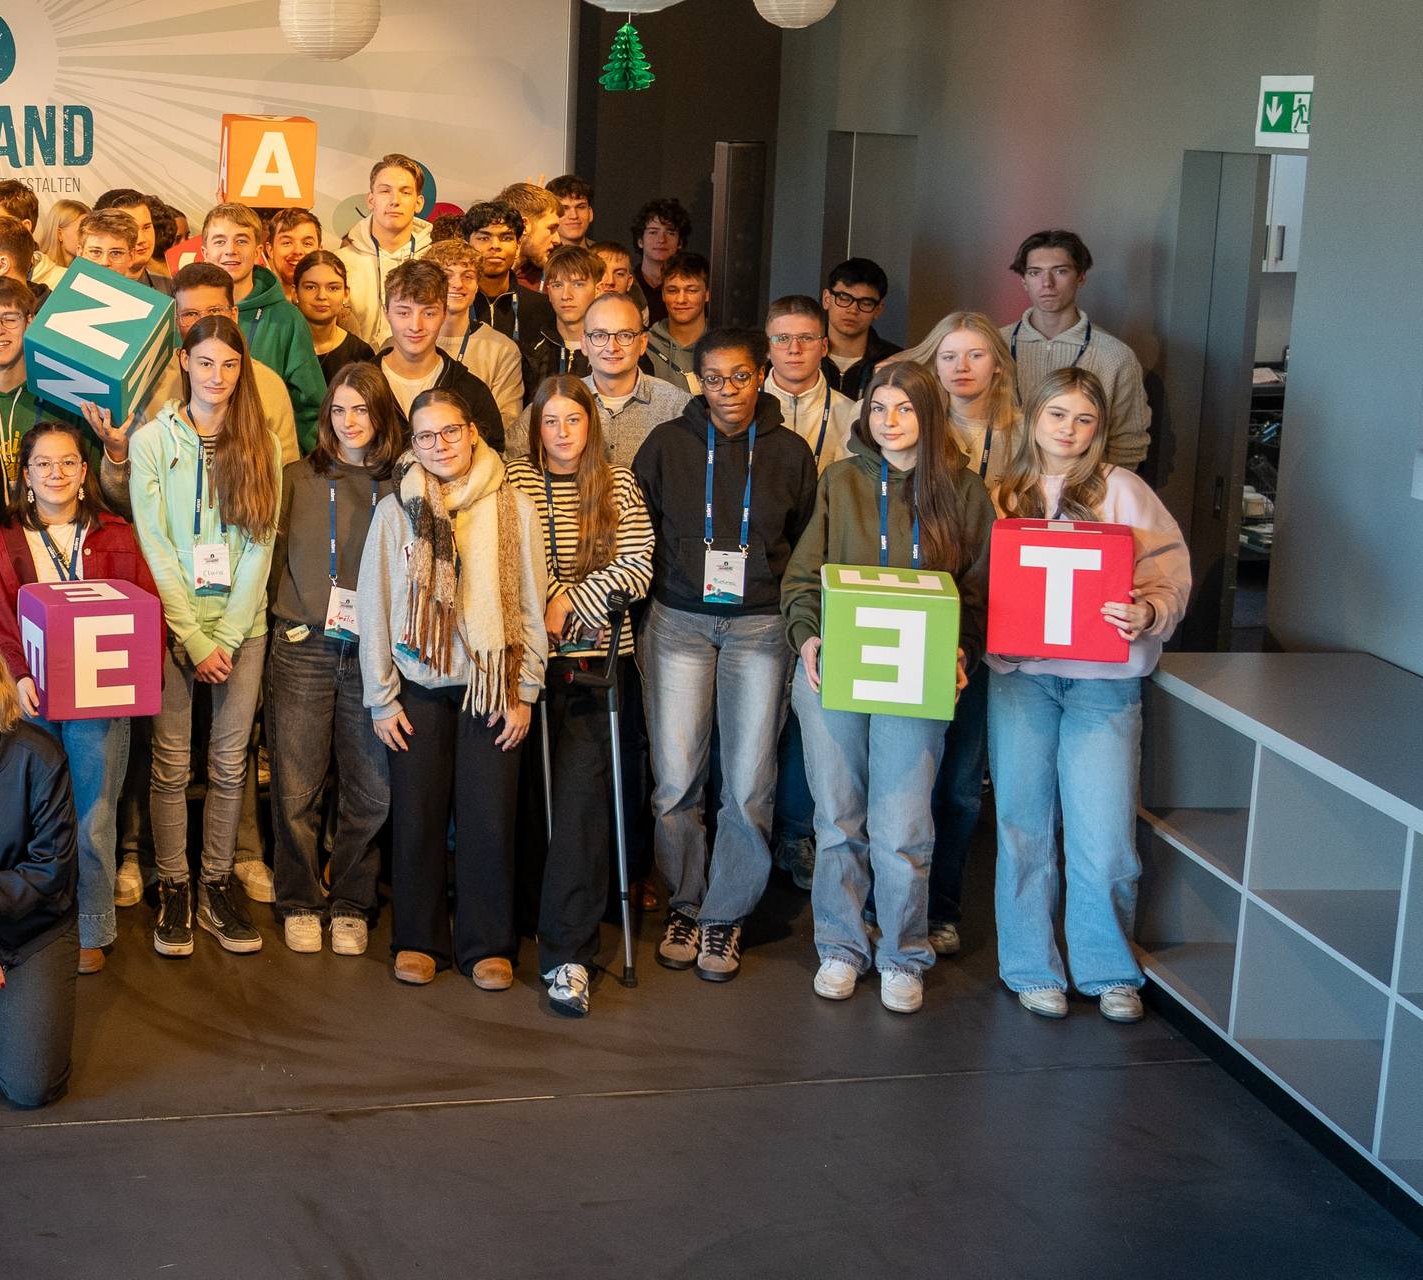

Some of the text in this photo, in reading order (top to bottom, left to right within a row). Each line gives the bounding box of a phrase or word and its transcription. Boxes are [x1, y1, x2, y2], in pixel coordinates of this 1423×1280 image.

[240, 131, 302, 198] A
[1020, 545, 1102, 646] T
[21, 614, 45, 691] E
[74, 614, 136, 708] E
[852, 606, 927, 705] E
